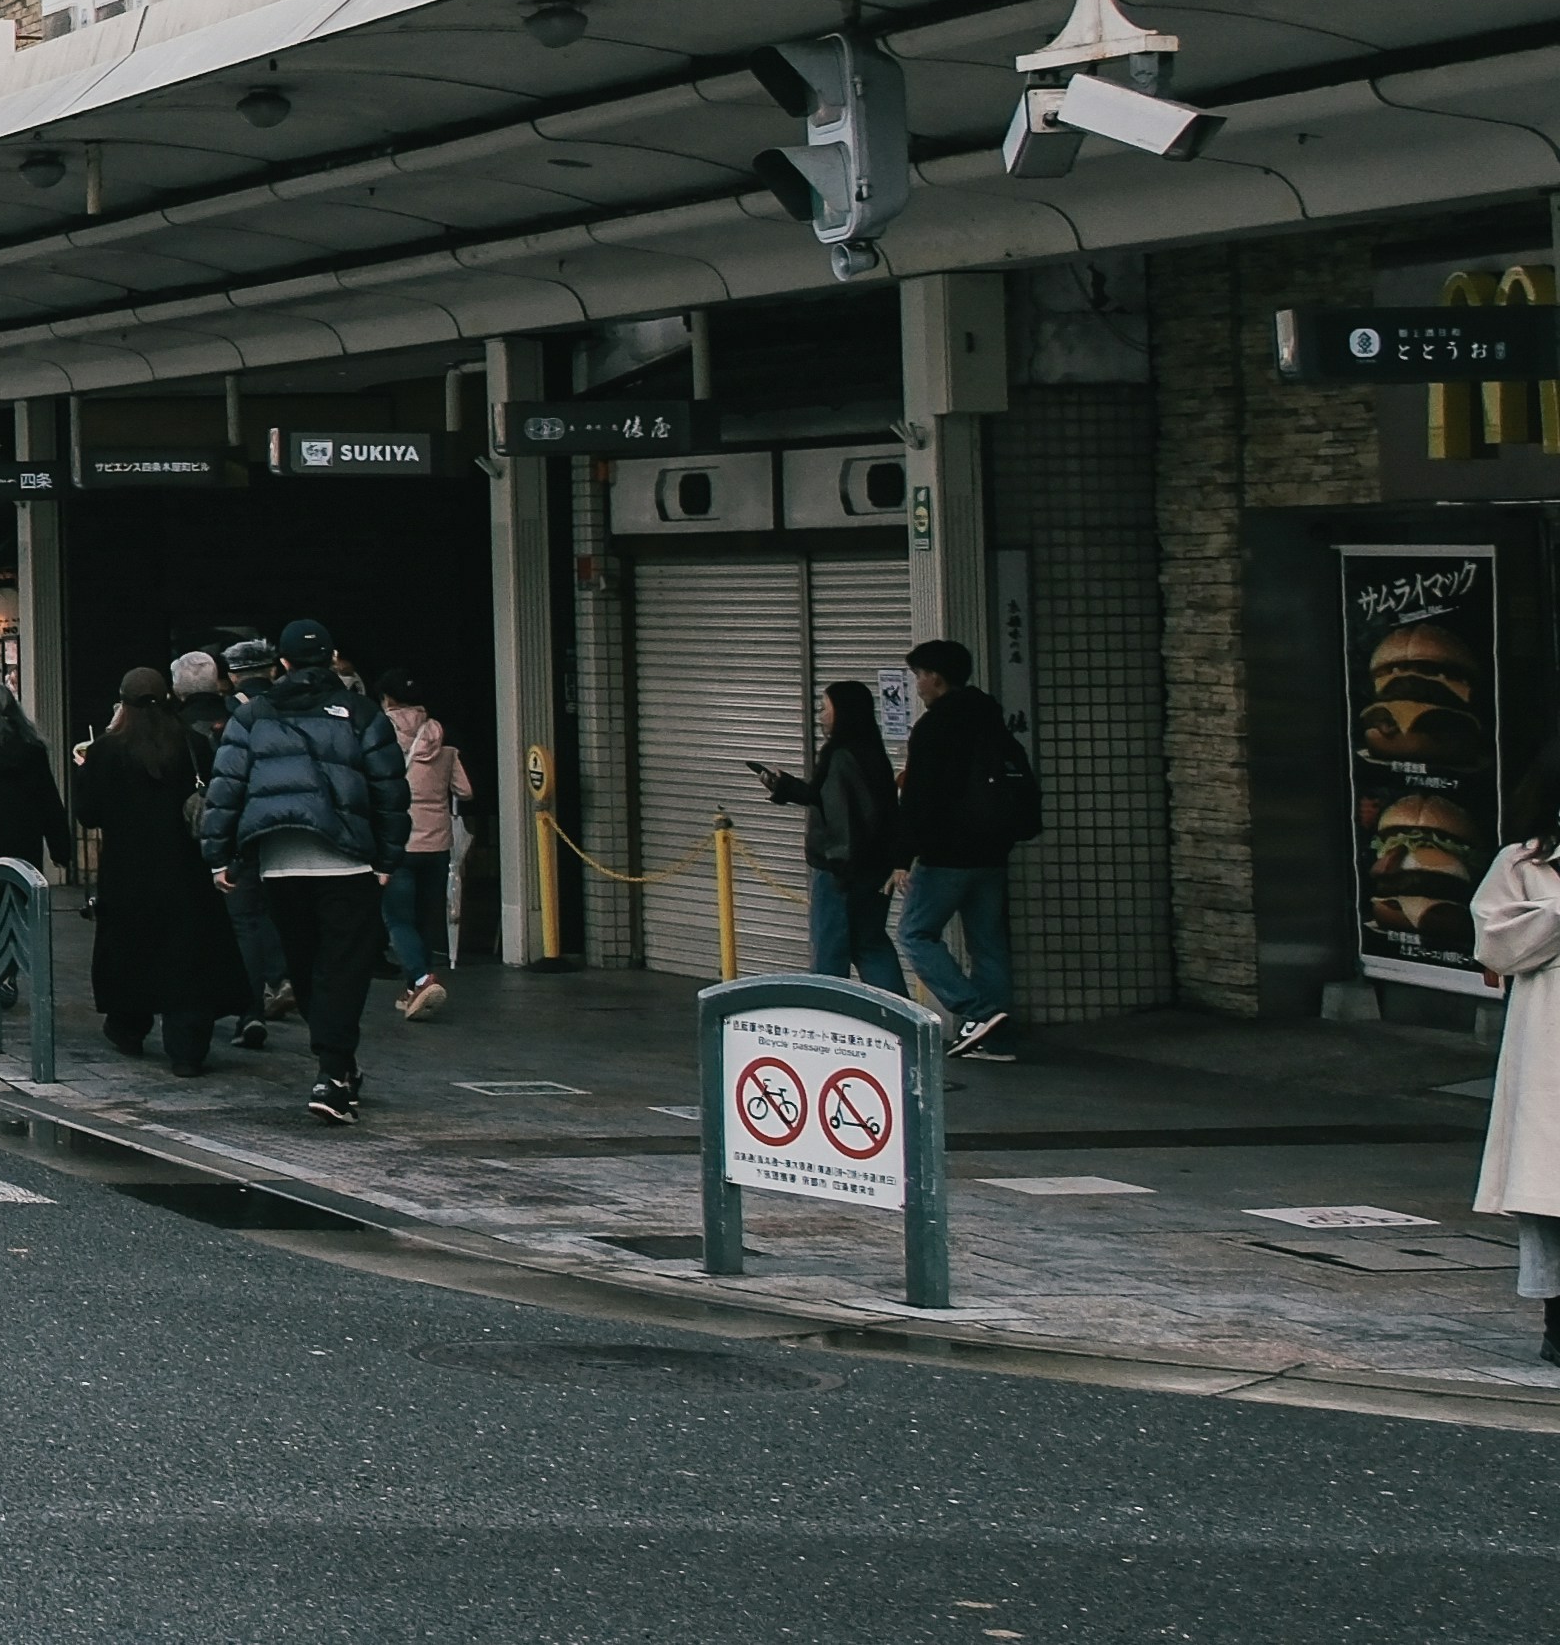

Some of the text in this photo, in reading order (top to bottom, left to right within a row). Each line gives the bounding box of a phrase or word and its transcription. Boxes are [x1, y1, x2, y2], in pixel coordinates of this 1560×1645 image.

[1397, 341, 1488, 361] ととうお
[340, 444, 420, 462] SUKIYA
[20, 472, 53, 490] 四条
[1357, 560, 1477, 621] サムライマック
[758, 1036, 868, 1059] Bicycle passage closure
